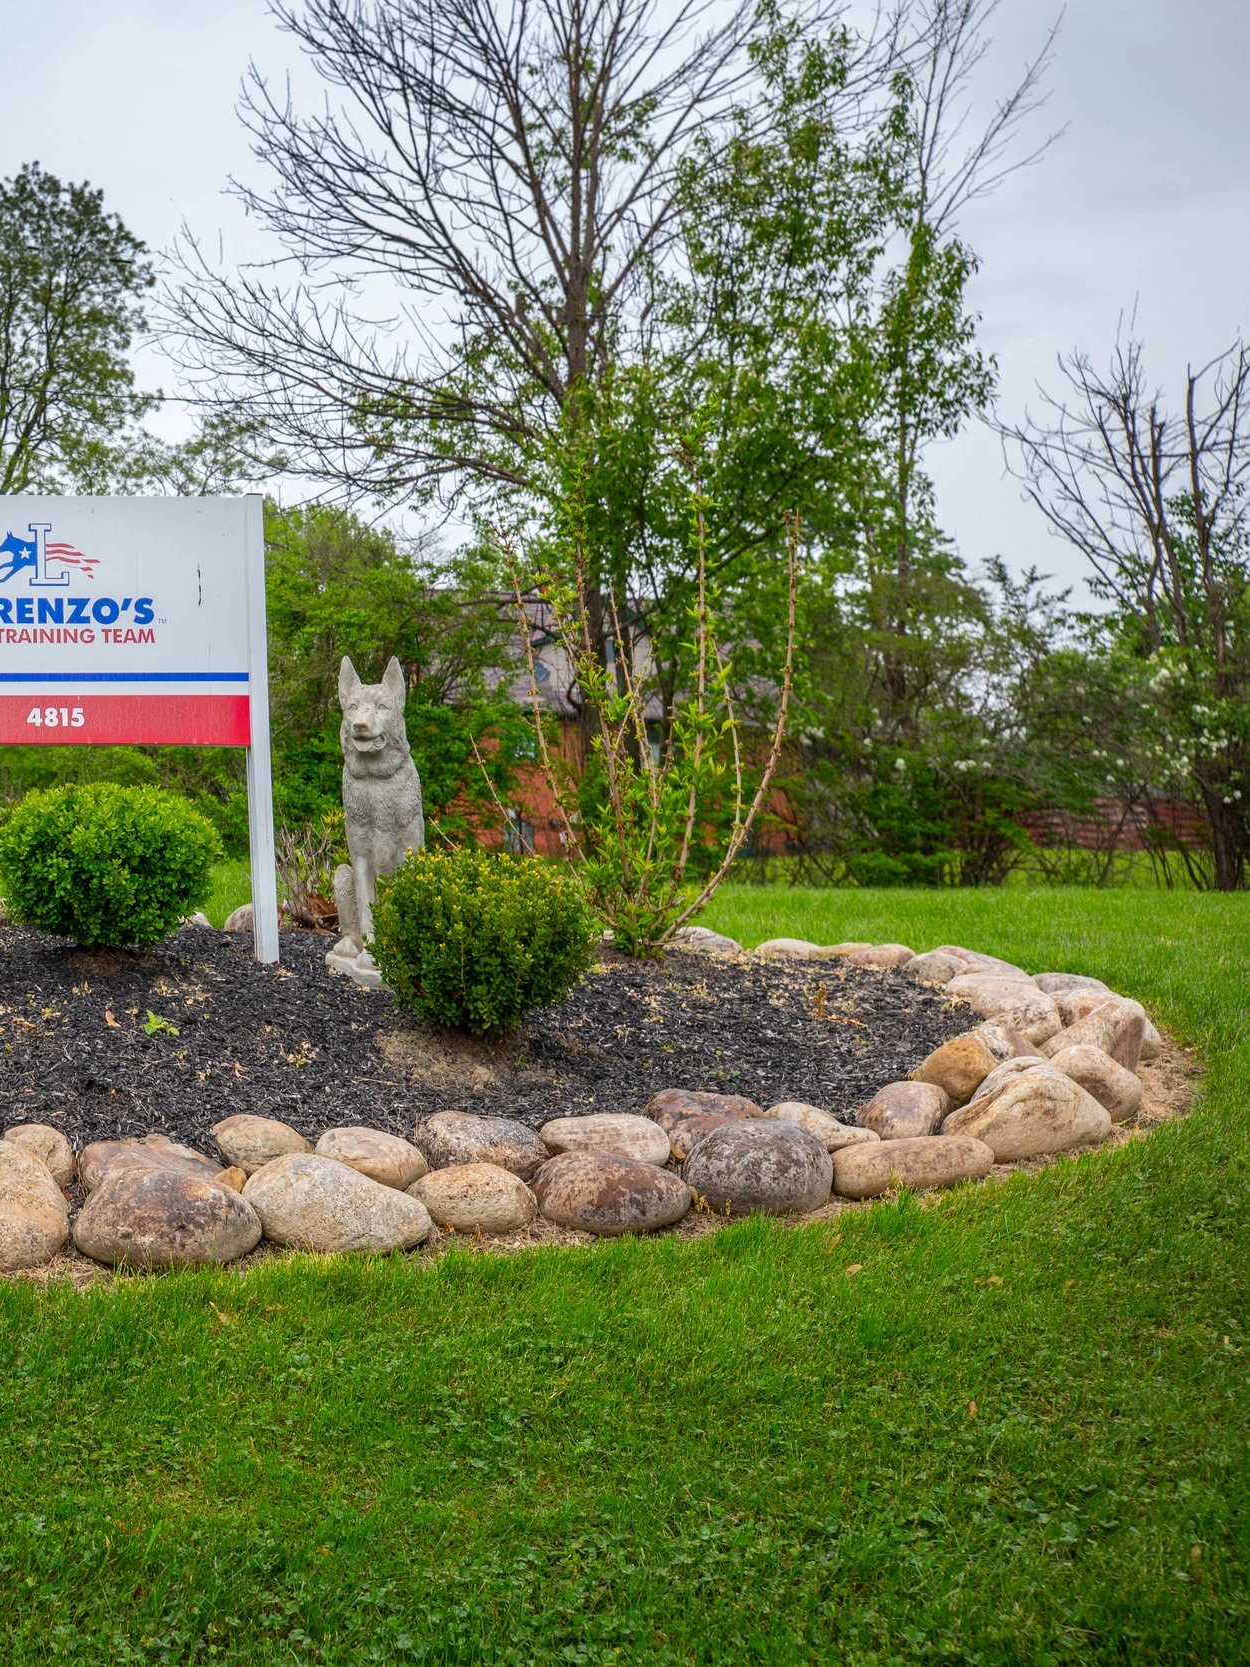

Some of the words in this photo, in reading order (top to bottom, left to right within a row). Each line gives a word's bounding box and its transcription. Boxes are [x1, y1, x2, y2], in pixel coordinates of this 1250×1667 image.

[28, 523, 70, 586] L
[102, 628, 155, 644] TEAM
[27, 707, 85, 727] 4815
